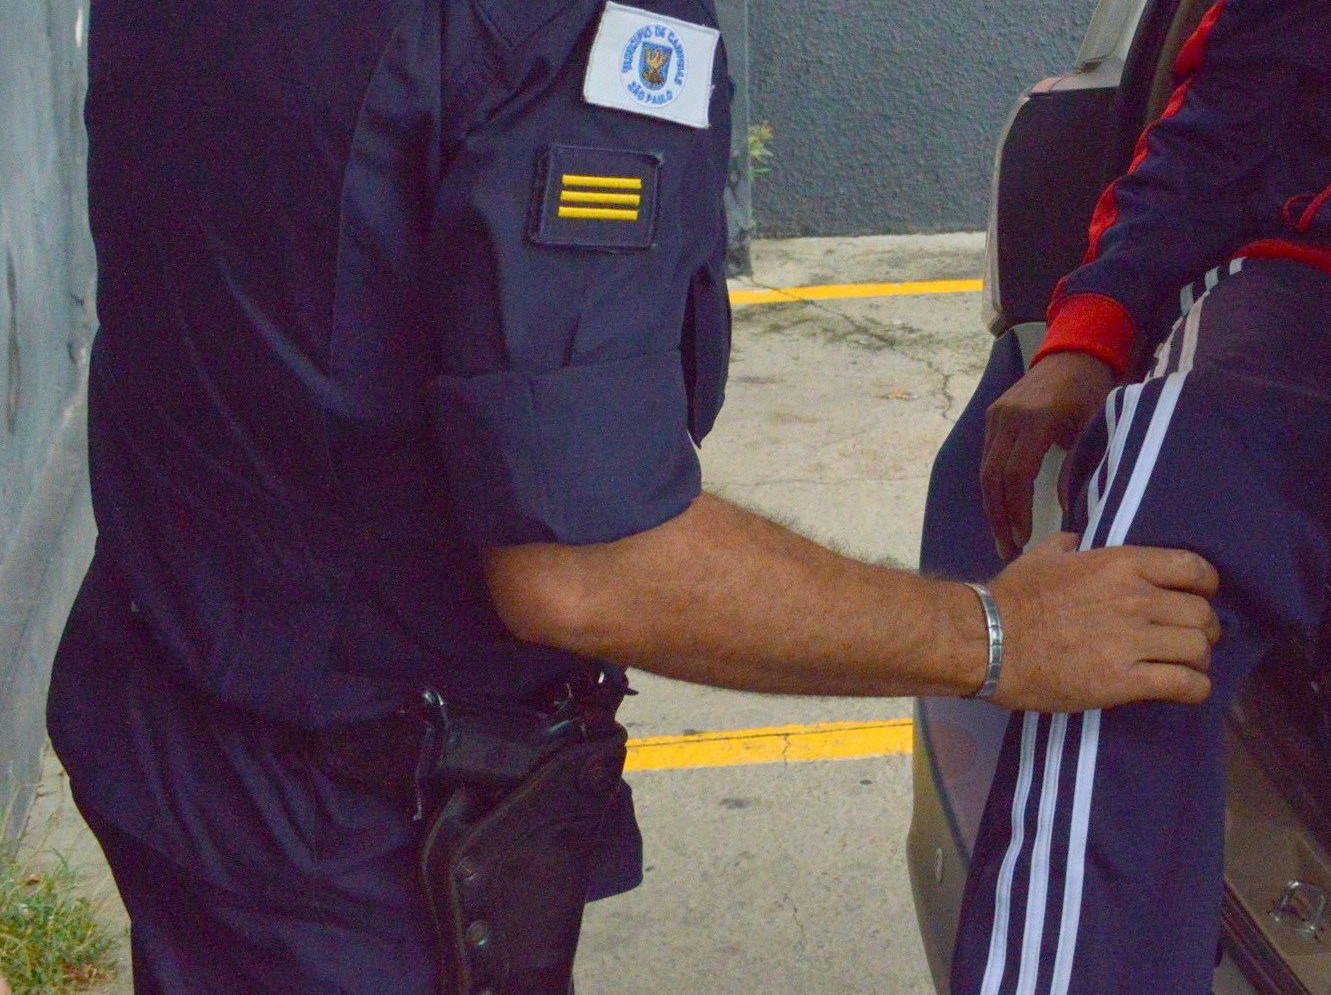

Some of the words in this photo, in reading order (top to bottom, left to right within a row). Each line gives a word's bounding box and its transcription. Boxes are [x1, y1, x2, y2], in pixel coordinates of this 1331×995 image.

[654, 24, 667, 38] DE
[627, 81, 645, 101] SÃO
[645, 90, 673, 104] PAULO
